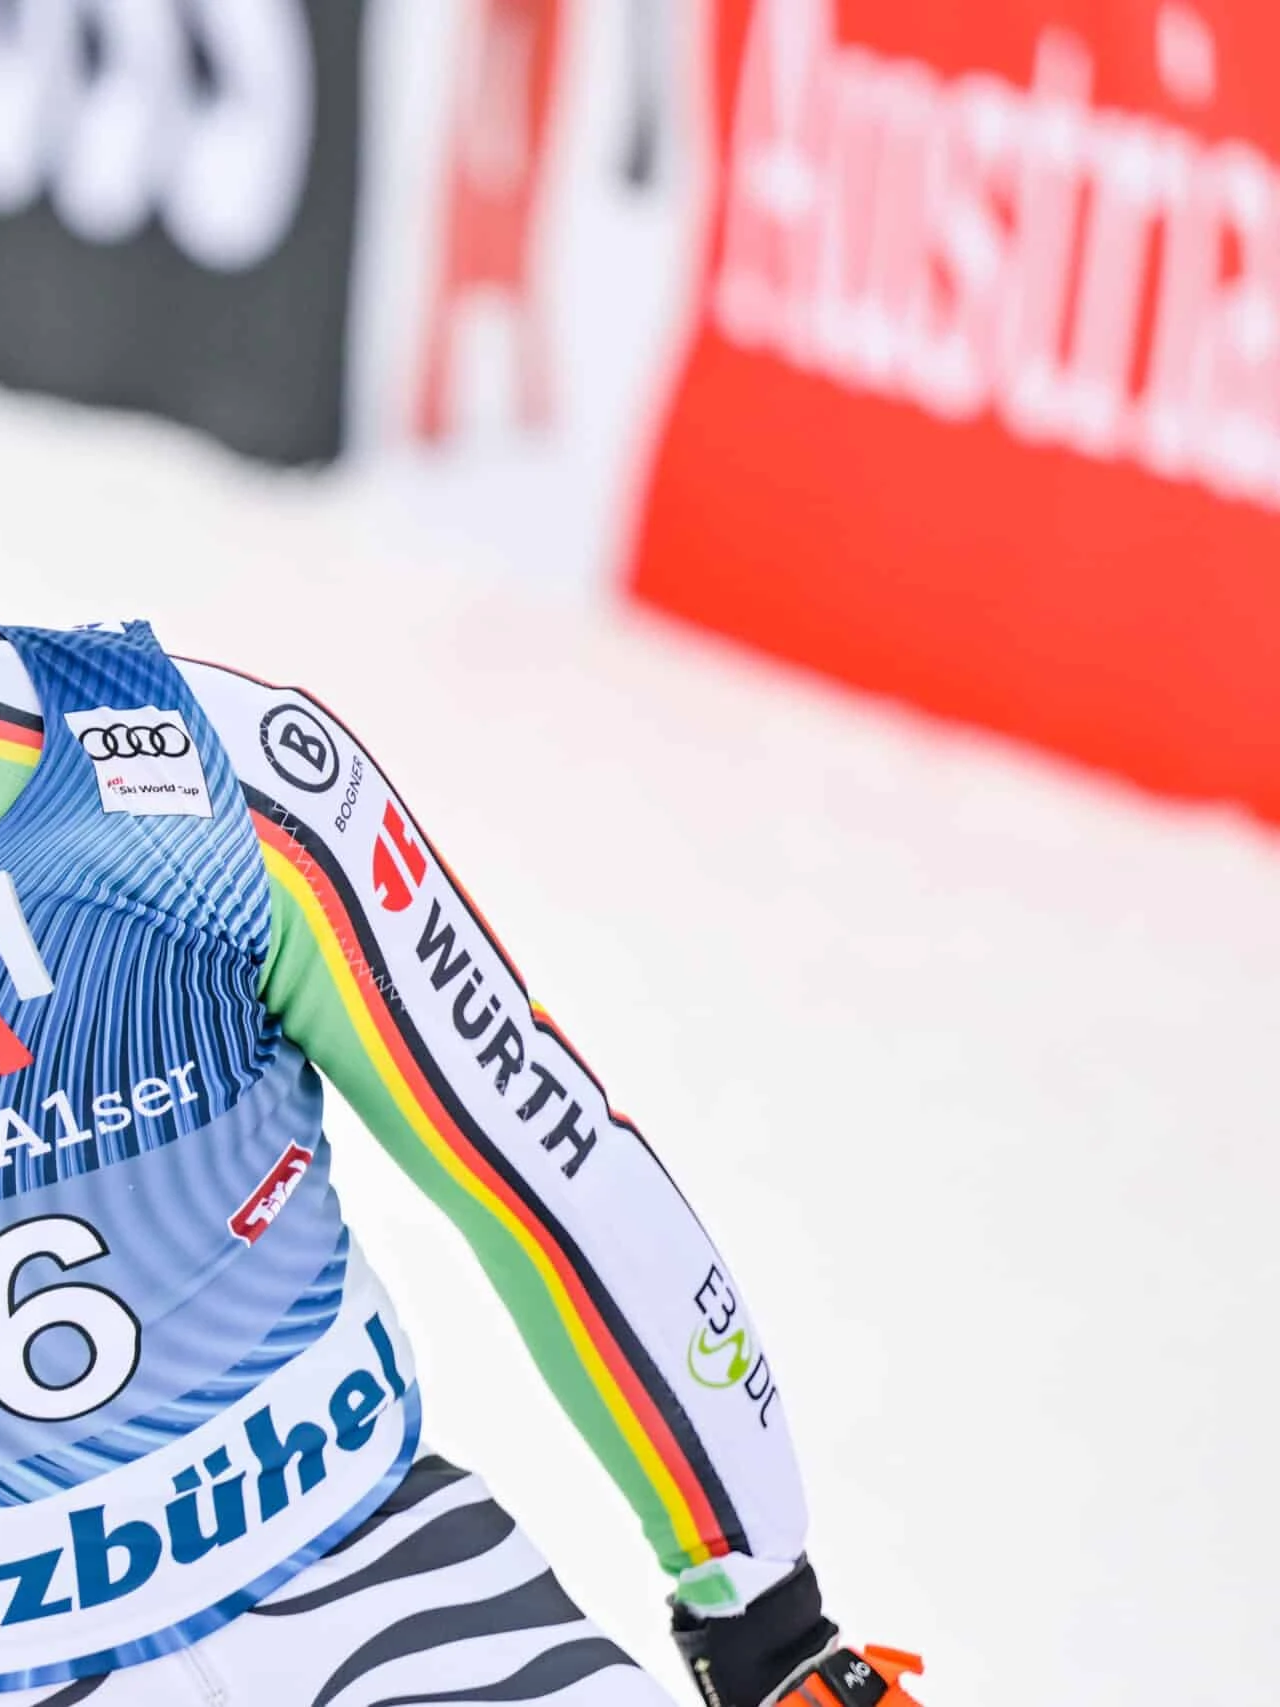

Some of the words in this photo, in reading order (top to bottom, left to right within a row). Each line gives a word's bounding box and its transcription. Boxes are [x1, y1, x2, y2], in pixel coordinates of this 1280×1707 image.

[139, 784, 176, 793] World
[178, 785, 199, 796] up
[334, 755, 374, 833] BOGNER
[415, 896, 597, 1180] WÜRTH
